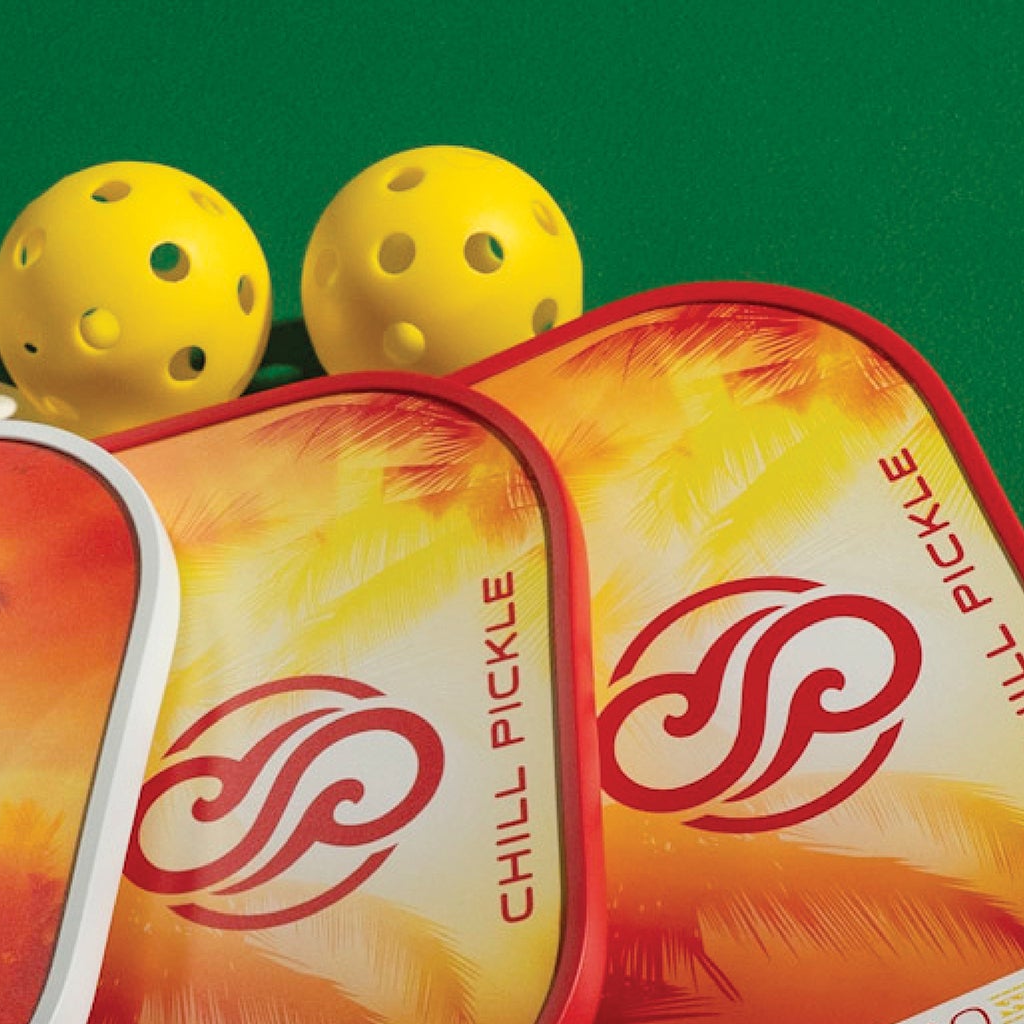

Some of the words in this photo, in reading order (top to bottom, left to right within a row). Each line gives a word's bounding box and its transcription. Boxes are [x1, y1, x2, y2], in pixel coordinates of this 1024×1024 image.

[878, 448, 993, 614] PICKLE
[482, 570, 525, 749] PICKLE
[986, 623, 1024, 716] ILL
[494, 765, 533, 923] CHILL
